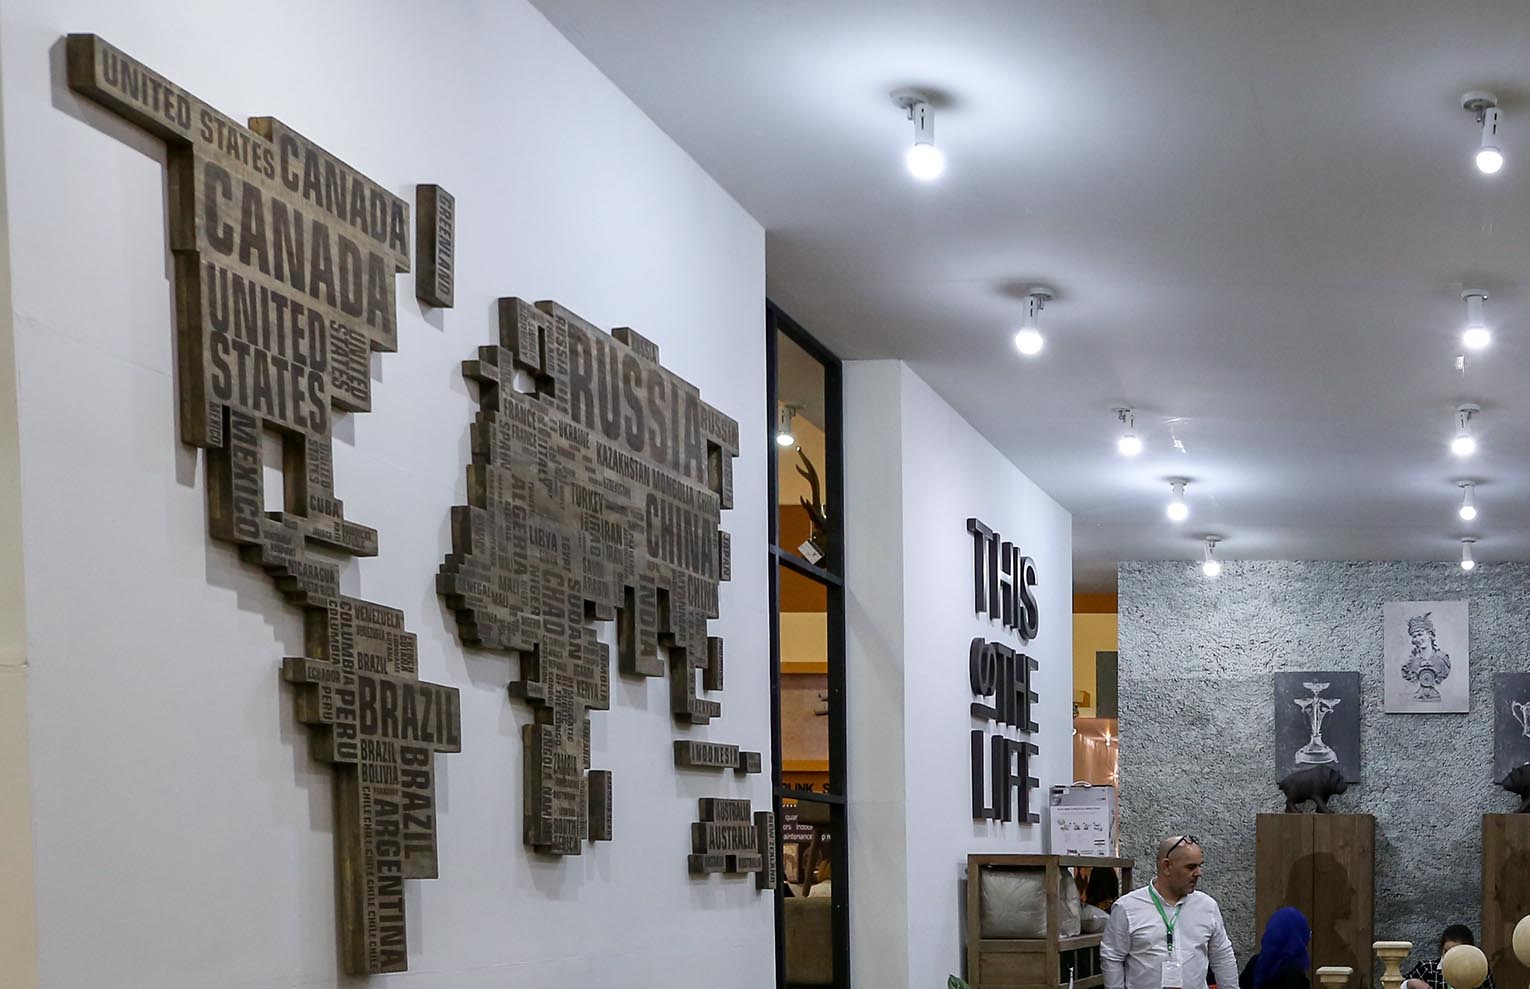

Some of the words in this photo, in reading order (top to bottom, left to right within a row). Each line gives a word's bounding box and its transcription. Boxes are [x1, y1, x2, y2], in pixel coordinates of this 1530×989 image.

[102, 47, 192, 131] UNITED
[200, 108, 275, 180] STATES
[279, 133, 407, 257] CANADA
[204, 161, 393, 335] CANADA
[436, 197, 452, 296] GREENLAND
[207, 262, 328, 373] UNITED
[555, 313, 569, 376] RUSSIA
[209, 330, 328, 435] STATES
[330, 320, 350, 391] STATES
[348, 327, 368, 400] UNITED
[207, 401, 222, 447] MEXICO
[503, 398, 537, 431] FRANCE
[566, 320, 705, 485] RUSSIA
[308, 438, 320, 485] STATES
[320, 441, 332, 489] UNITED
[500, 420, 512, 471] SPAIN
[538, 441, 552, 490] ITALY
[558, 420, 590, 450] UKRAINE
[231, 408, 261, 540] MEXICO
[570, 481, 604, 515] TURKEY
[596, 440, 650, 487] KAZAKHSTAN
[651, 468, 695, 502] MONGOLIA
[310, 495, 341, 519] CUBA
[512, 473, 528, 575] ALGERIA
[528, 523, 559, 552] LIBYA
[601, 518, 623, 548] IRAN
[646, 492, 713, 582] CHINA
[499, 575, 520, 595] MALI
[722, 533, 731, 578] JAPAN
[966, 516, 1040, 641] THIS
[354, 603, 400, 630] VENEZUELA
[530, 565, 541, 616] NIGER
[541, 568, 566, 637] CHAD
[567, 577, 583, 661] SUDAN
[639, 574, 657, 657] INDIA
[686, 573, 718, 614] CHINA
[329, 600, 340, 665] COLUMBIA
[340, 601, 355, 685] COLUMBIA
[357, 652, 388, 675] BRAZIL
[322, 686, 332, 720] PERU
[357, 675, 459, 746] BRAZIL
[576, 679, 599, 700] KENYA
[991, 642, 1039, 734] THE
[335, 689, 357, 760] PERU
[360, 739, 397, 763] BRAZIL
[690, 742, 738, 767] INDONESIA
[361, 763, 399, 785] BOLIVIA
[362, 786, 371, 815] CHILE
[400, 746, 433, 860] BRAZIL
[970, 730, 1041, 825] LIFE
[708, 824, 757, 850] AUSTRALIA
[715, 801, 751, 822] AUSTRALIA
[374, 798, 404, 970] ARGENTINA
